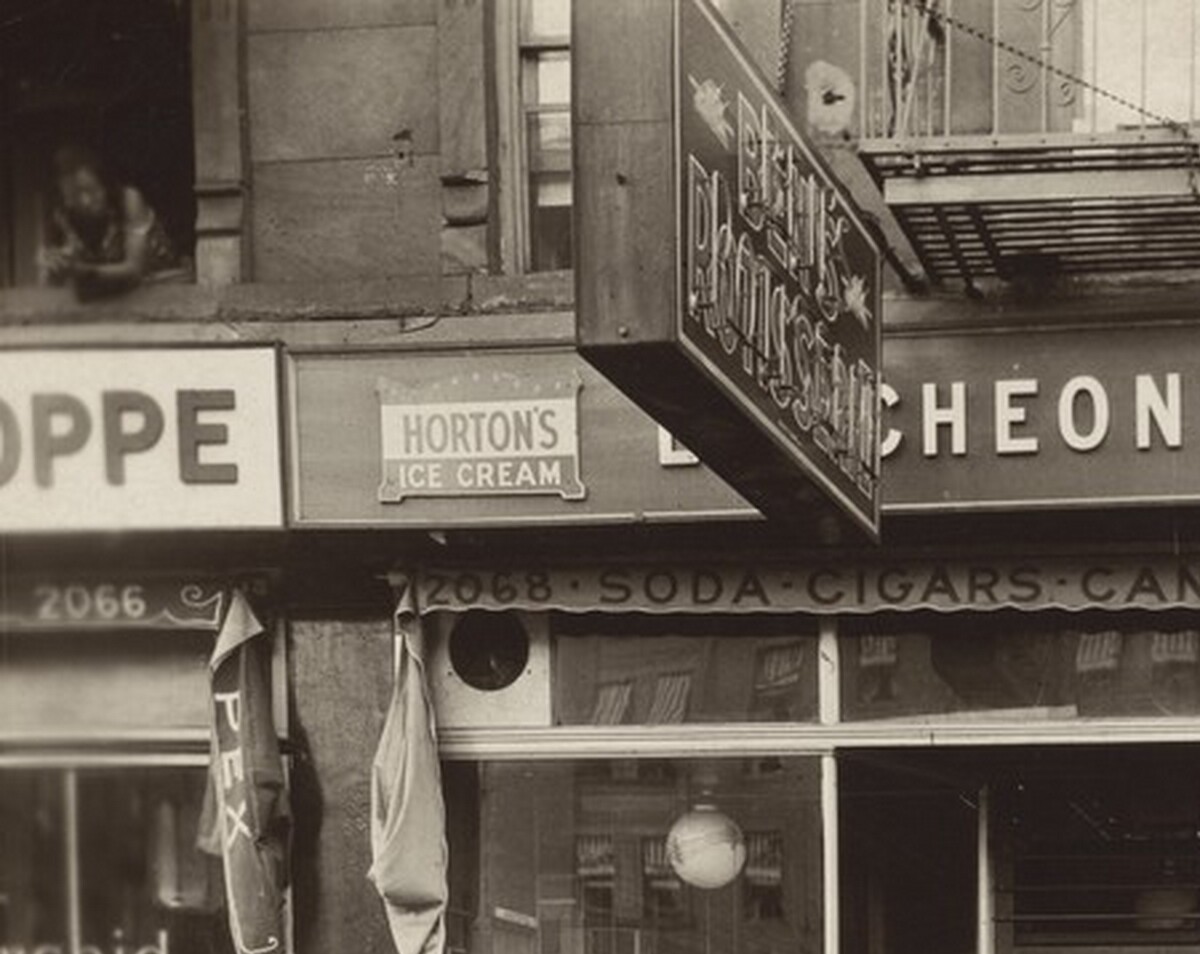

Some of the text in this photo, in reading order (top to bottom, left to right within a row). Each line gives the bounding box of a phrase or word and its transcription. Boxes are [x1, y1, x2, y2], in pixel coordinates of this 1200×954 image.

[402, 406, 559, 457] HORTON'S
[400, 459, 562, 489] ICE CREAM
[36, 584, 147, 620] 2066
[424, 572, 553, 606] 2068
[600, 568, 772, 607] SODA
[805, 565, 1043, 604] CIGARS
